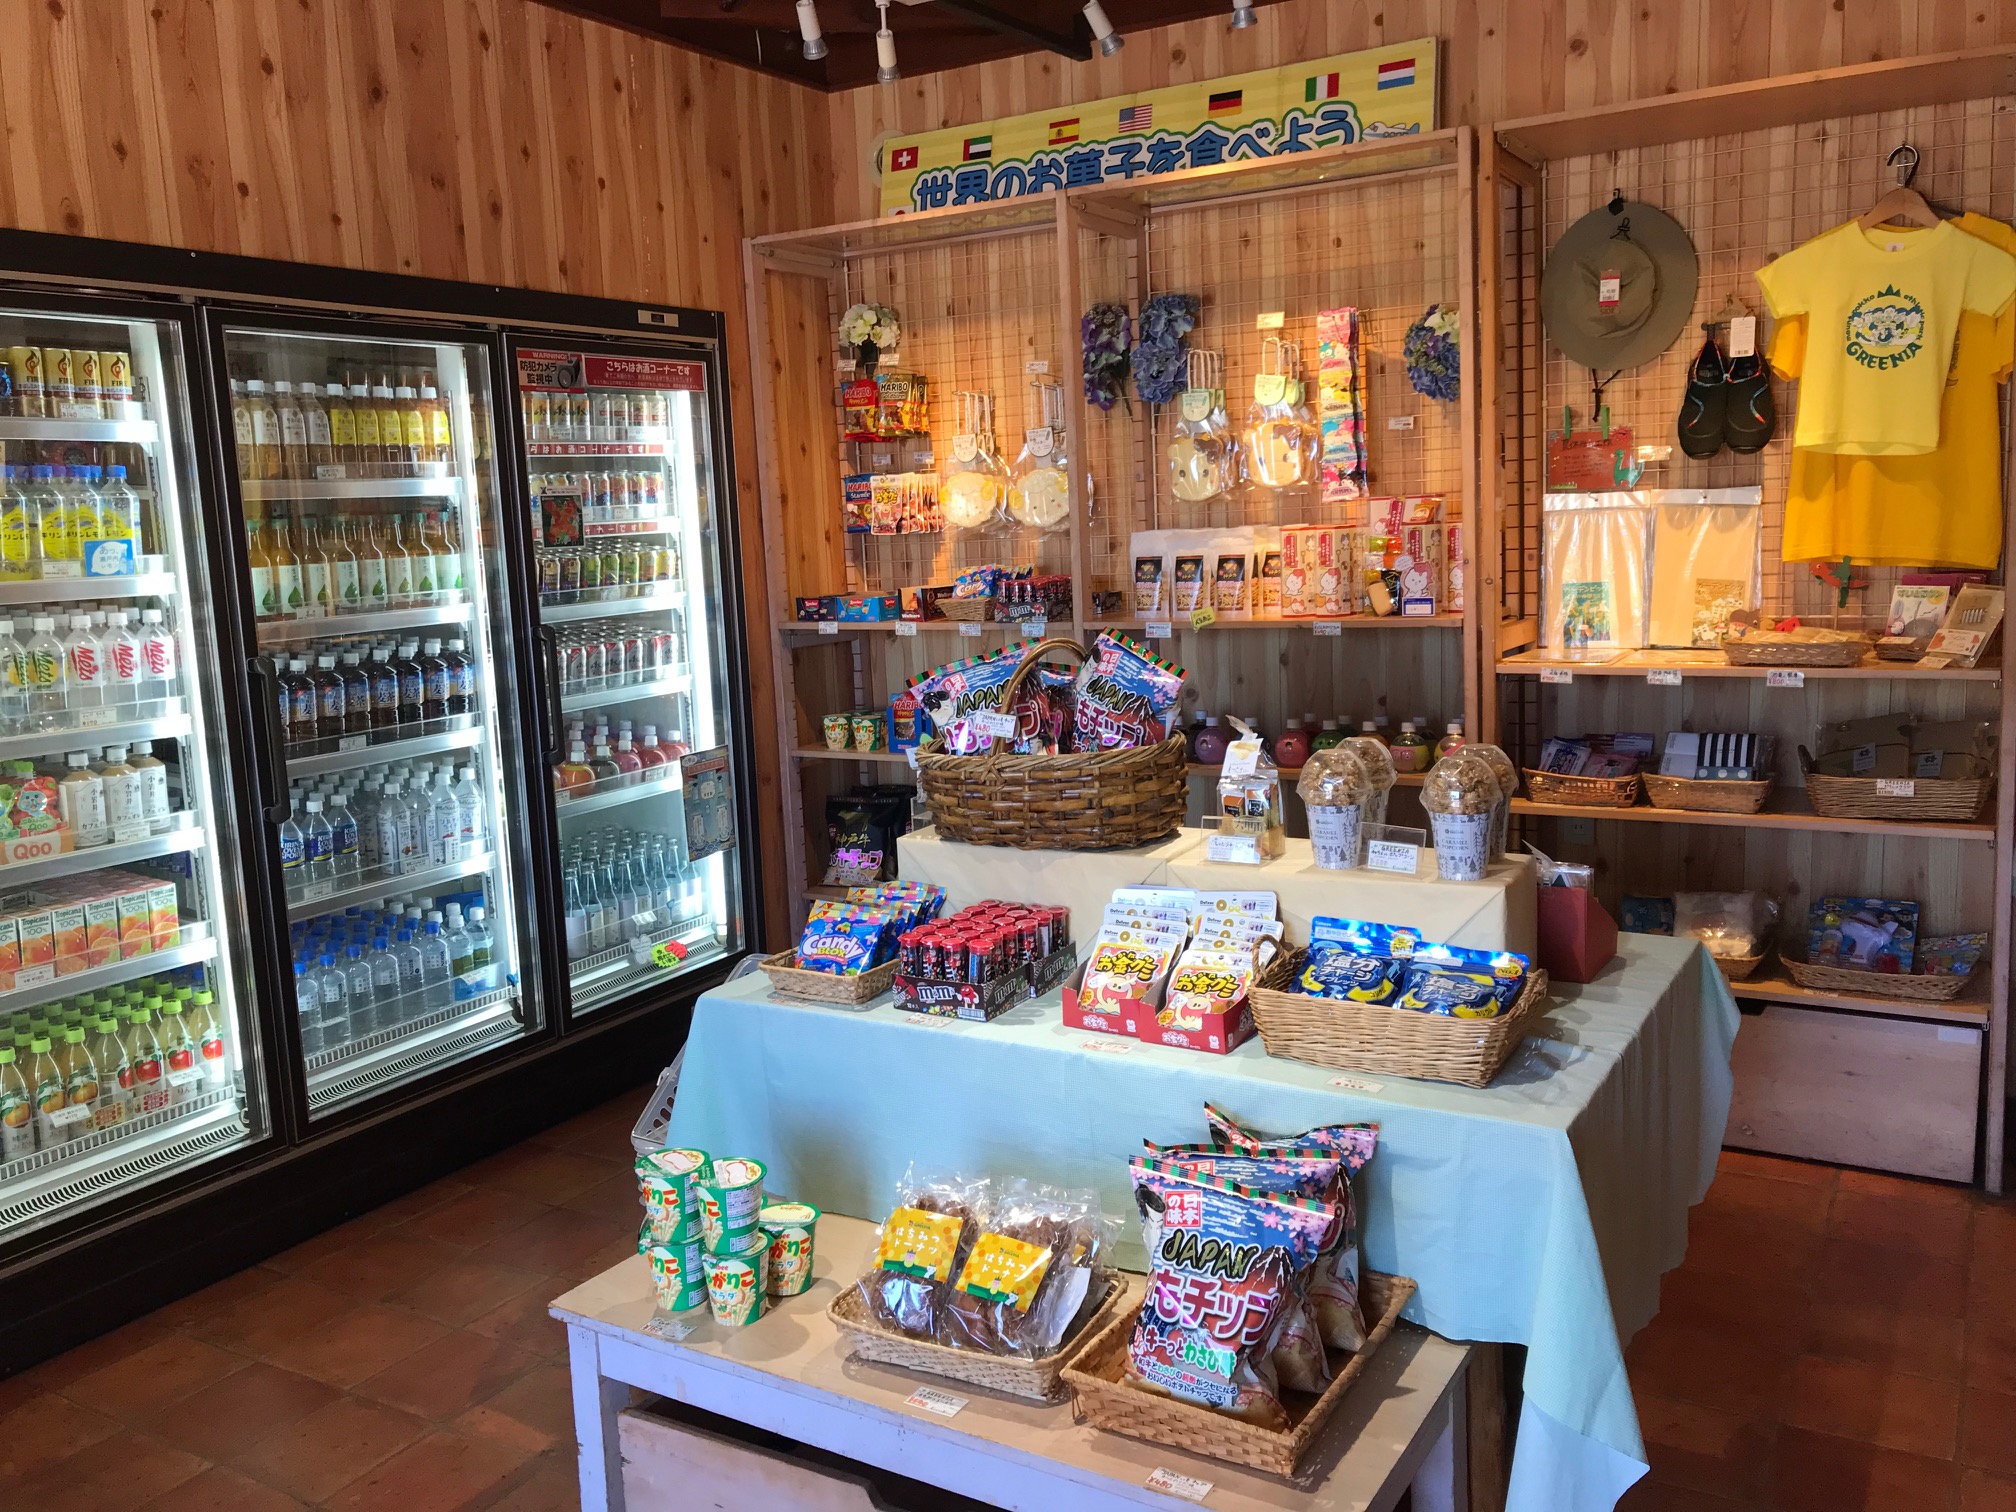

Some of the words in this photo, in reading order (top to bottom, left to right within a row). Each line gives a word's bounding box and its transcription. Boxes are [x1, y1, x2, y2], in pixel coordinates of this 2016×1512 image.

[917, 109, 1361, 211] 世界のお菓子を食べよう
[1846, 341, 1923, 371] GREENIA
[520, 360, 557, 373] 防犯カメラ
[606, 361, 691, 375] こちらはお酒コーナーです
[527, 373, 553, 384] 監視中
[844, 387, 872, 398] HARIBO
[881, 382, 909, 392] HARIBO
[956, 581, 986, 597] Candy
[77, 645, 95, 681] Mets
[118, 643, 134, 678] Mets
[150, 639, 165, 674] Mets
[37, 650, 53, 682] Mets
[1086, 674, 1136, 713] JAPAN
[974, 723, 991, 733] ¥480
[14, 842, 52, 860] Qoo
[88, 900, 114, 911] Tropicana
[122, 892, 145, 904] Tropicana
[21, 914, 49, 926] Tropicana
[54, 906, 82, 918] Tropicana
[26, 927, 47, 936] 100%
[60, 919, 81, 929] 100%
[802, 935, 865, 958] Candy
[817, 947, 845, 957] BLOX
[1095, 951, 1159, 982] お金グミ
[1325, 955, 1381, 971] 塩分
[1320, 966, 1373, 981] チャージ
[1498, 968, 1519, 976] No.1
[1173, 972, 1240, 998] お金グミ
[1427, 976, 1482, 993] 塩分
[1167, 1193, 1198, 1226] 日本の味
[896, 1227, 940, 1243] はちみつ
[894, 1238, 938, 1254] ドーナツ
[1162, 1229, 1260, 1279] JAPAN
[985, 1253, 1028, 1271] はちみつ
[711, 1290, 738, 1301] サラダ
[1148, 1476, 1172, 1489] ¥480
